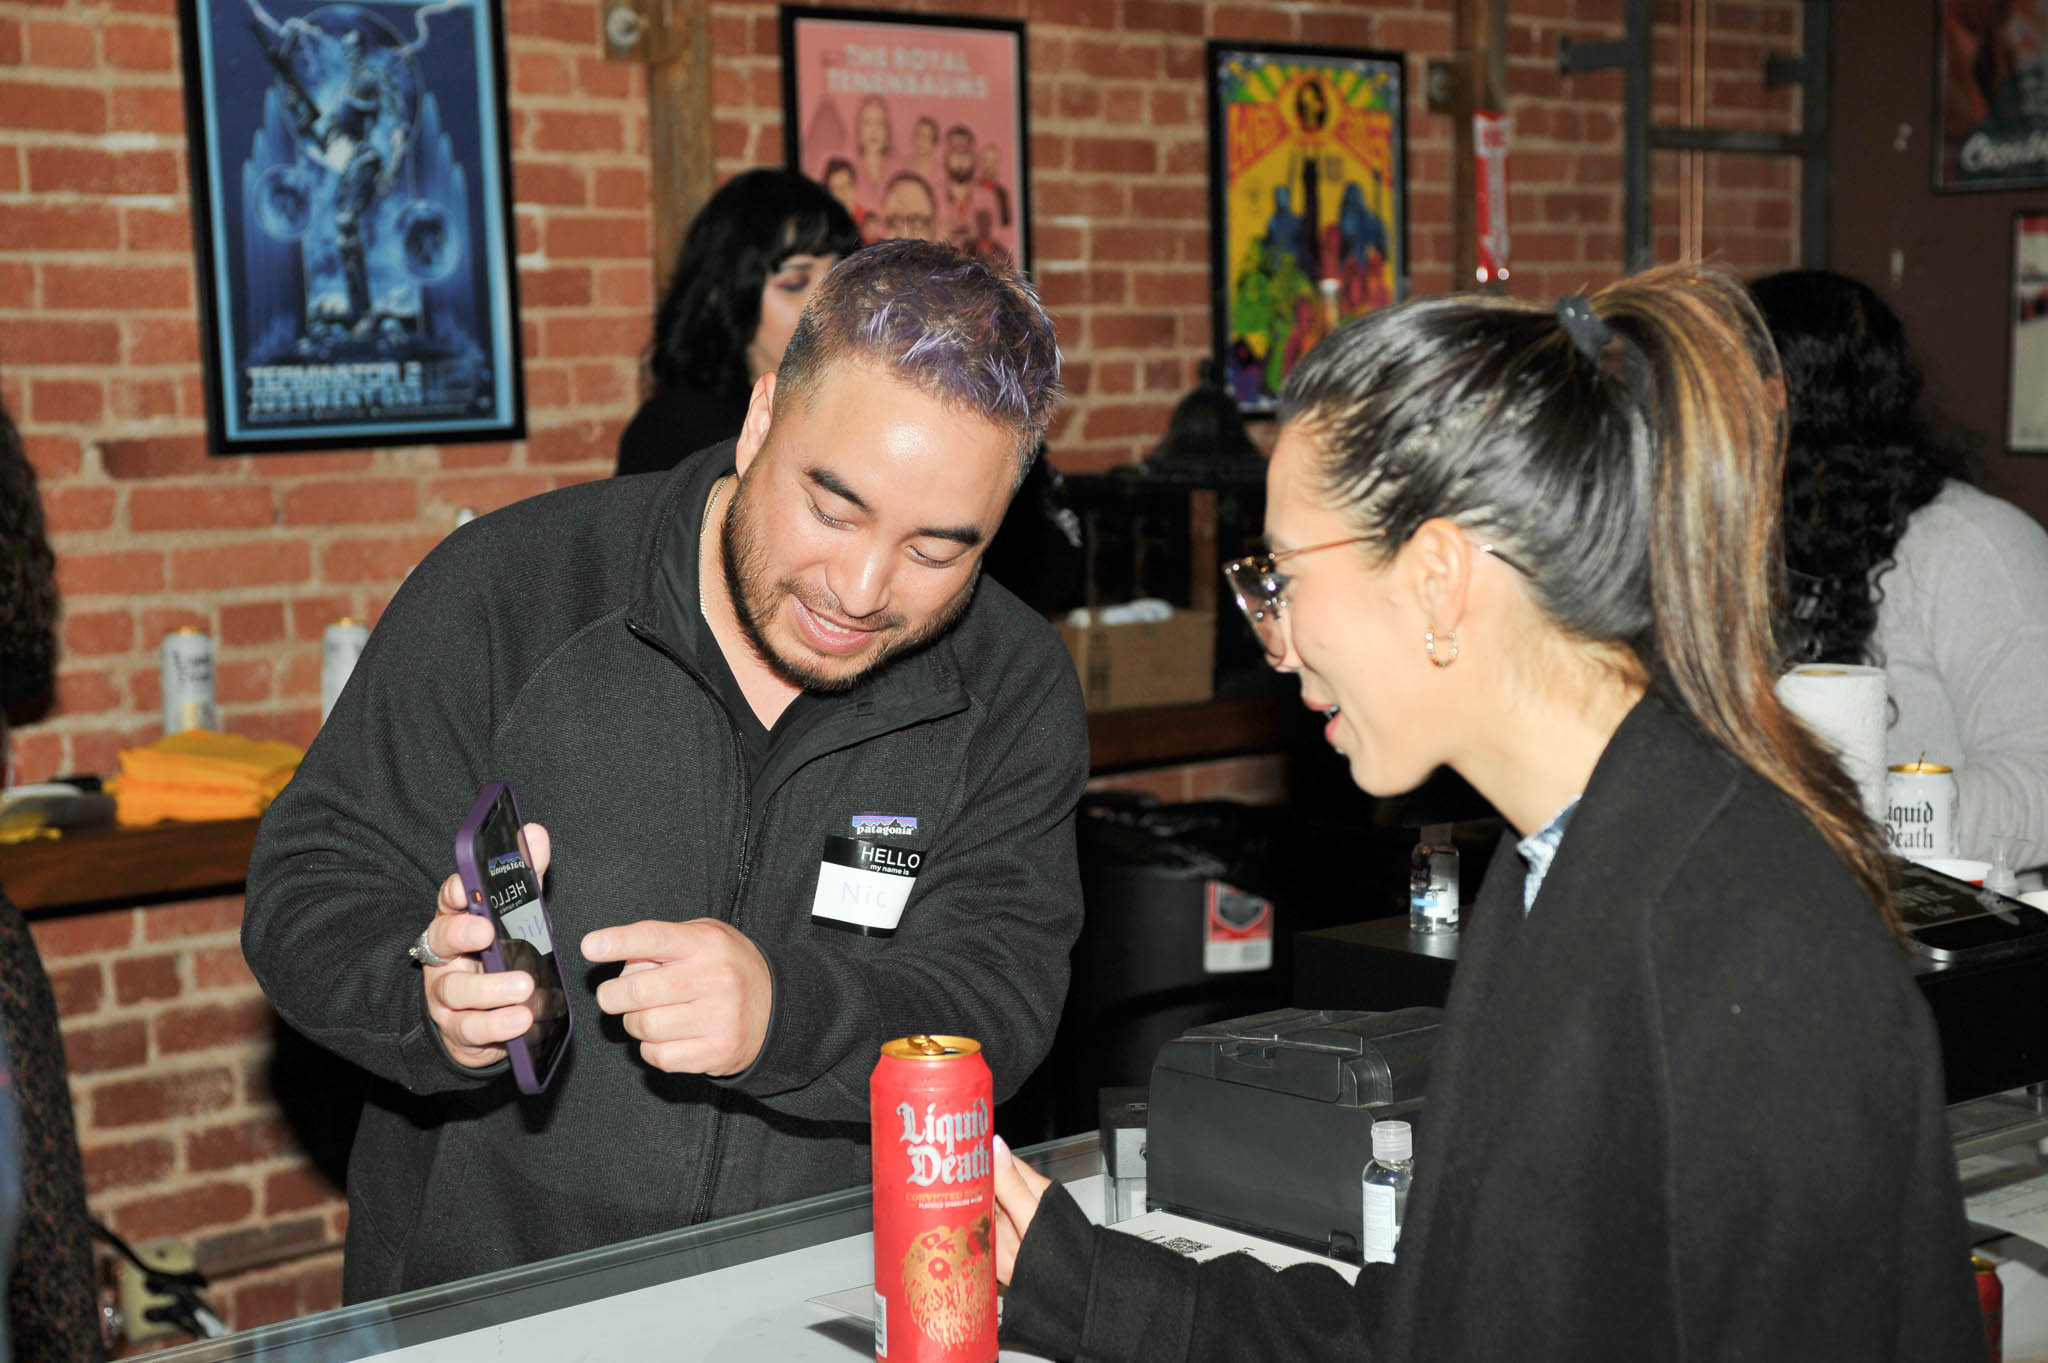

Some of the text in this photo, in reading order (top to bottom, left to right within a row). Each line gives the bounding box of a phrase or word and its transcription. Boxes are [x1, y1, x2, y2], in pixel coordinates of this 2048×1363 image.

[843, 44, 970, 73] THE ROYAL
[1885, 798, 1933, 828] iquid
[856, 825, 913, 835] patagonia
[861, 846, 920, 868] HELLO
[870, 863, 909, 876] my name is
[896, 1097, 988, 1155] Liquid
[906, 1138, 990, 1186] Death
